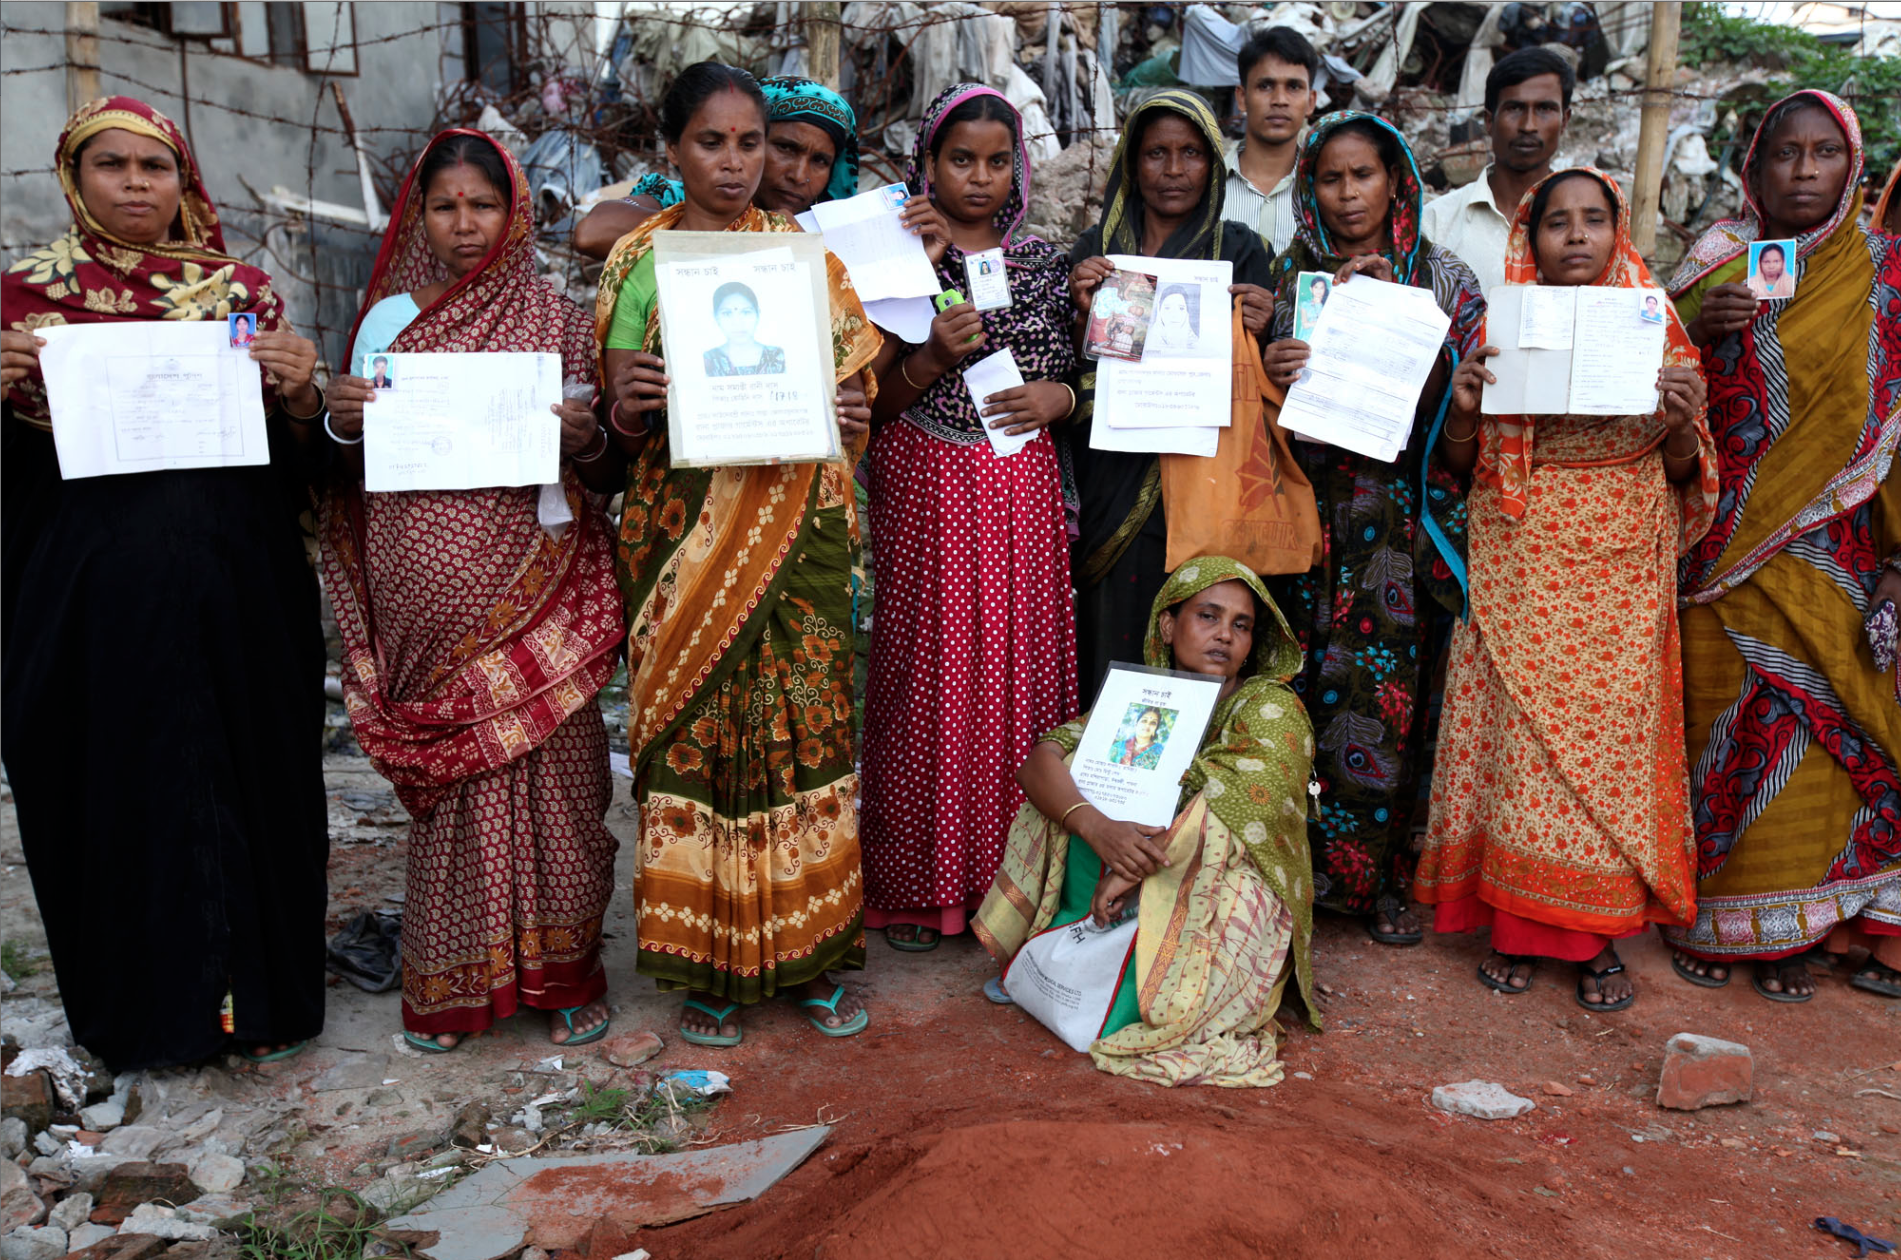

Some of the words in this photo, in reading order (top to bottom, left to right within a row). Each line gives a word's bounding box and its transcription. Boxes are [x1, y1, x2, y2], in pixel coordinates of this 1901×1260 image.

[676, 267, 700, 277] সন্ধান
[704, 266, 719, 276] চাই
[753, 264, 777, 274] সন্ধান
[1142, 688, 1160, 697] সন্ধান
[1161, 691, 1172, 699] চাই
[1057, 983, 1074, 994] SERVICES
